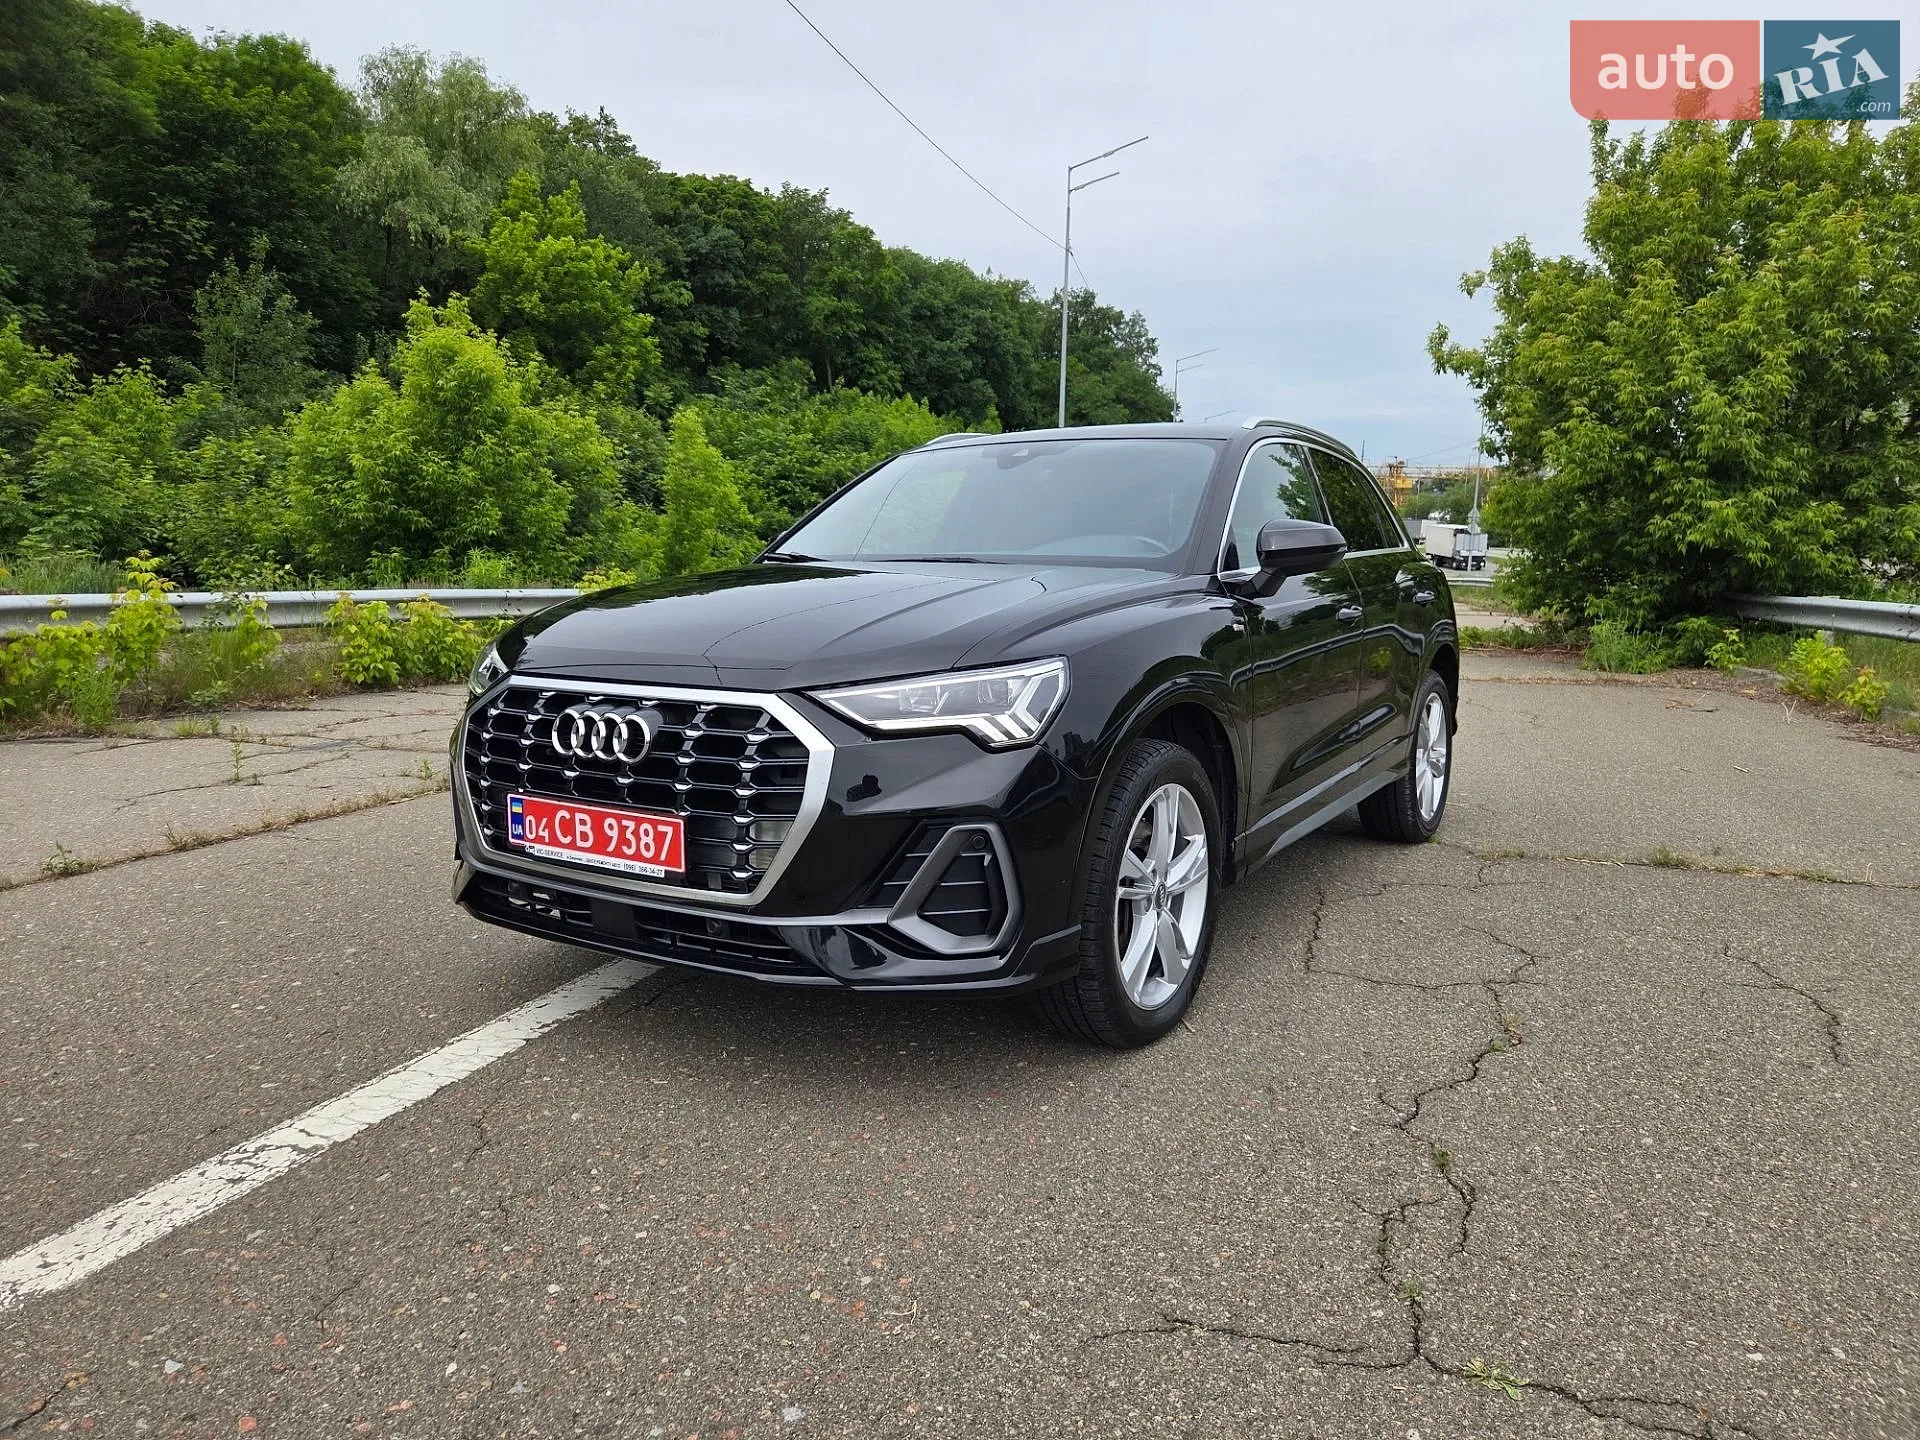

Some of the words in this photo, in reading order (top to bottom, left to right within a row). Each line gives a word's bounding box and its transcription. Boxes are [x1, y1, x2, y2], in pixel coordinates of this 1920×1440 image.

[512, 824, 523, 836] UA
[525, 814, 549, 843] 04
[554, 809, 594, 848] CB
[603, 817, 674, 861] 9387
